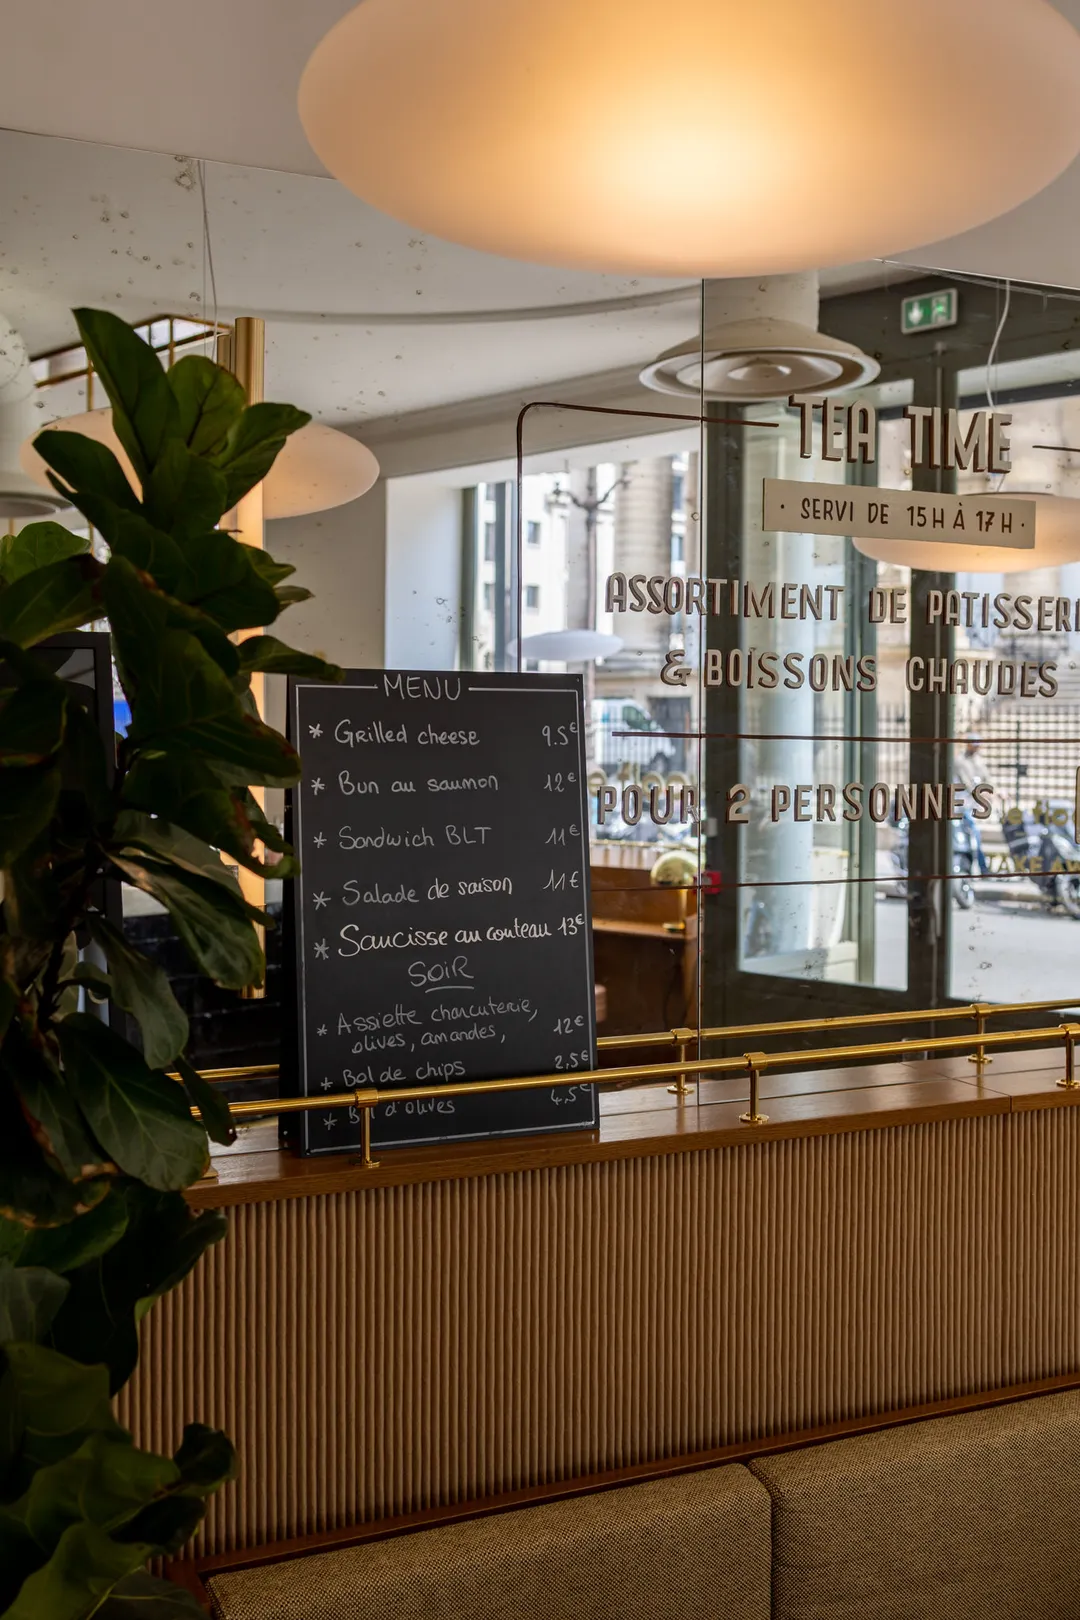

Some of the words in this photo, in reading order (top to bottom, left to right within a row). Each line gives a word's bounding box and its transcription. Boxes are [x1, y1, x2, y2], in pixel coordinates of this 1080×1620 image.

[788, 393, 876, 464] TEA
[903, 405, 1013, 474] TIME
[801, 497, 854, 523] SERVI
[868, 503, 889, 525] DE
[605, 571, 846, 621] ASSORTIMENT
[869, 586, 907, 624] DE
[660, 649, 692, 686] &
[703, 647, 878, 692] BOISSONS
[906, 656, 1059, 697] CHAUDES
[383, 673, 461, 700] MENU
[417, 724, 480, 745] cheese
[338, 770, 379, 795] Bun
[391, 780, 416, 793] au
[427, 775, 499, 792] saumon
[543, 772, 577, 793] 12€
[597, 785, 699, 825] POUR
[726, 783, 751, 823] 2
[771, 782, 994, 823] PERSONNES
[338, 825, 434, 850] Sandwich
[445, 824, 492, 846] BLT
[545, 824, 580, 847] 11€
[342, 880, 419, 906] Salade
[427, 877, 450, 900] de
[457, 876, 513, 895] saison
[543, 869, 579, 891] 11€
[338, 924, 448, 957] Saucisse
[455, 928, 482, 943] au
[486, 917, 552, 942] couteau
[337, 1004, 422, 1035] Assiette
[553, 1015, 584, 1035] 12€
[343, 1066, 374, 1087] Bol
[379, 1066, 406, 1083] de
[416, 1061, 466, 1082] chips
[349, 1105, 376, 1124] Bl
